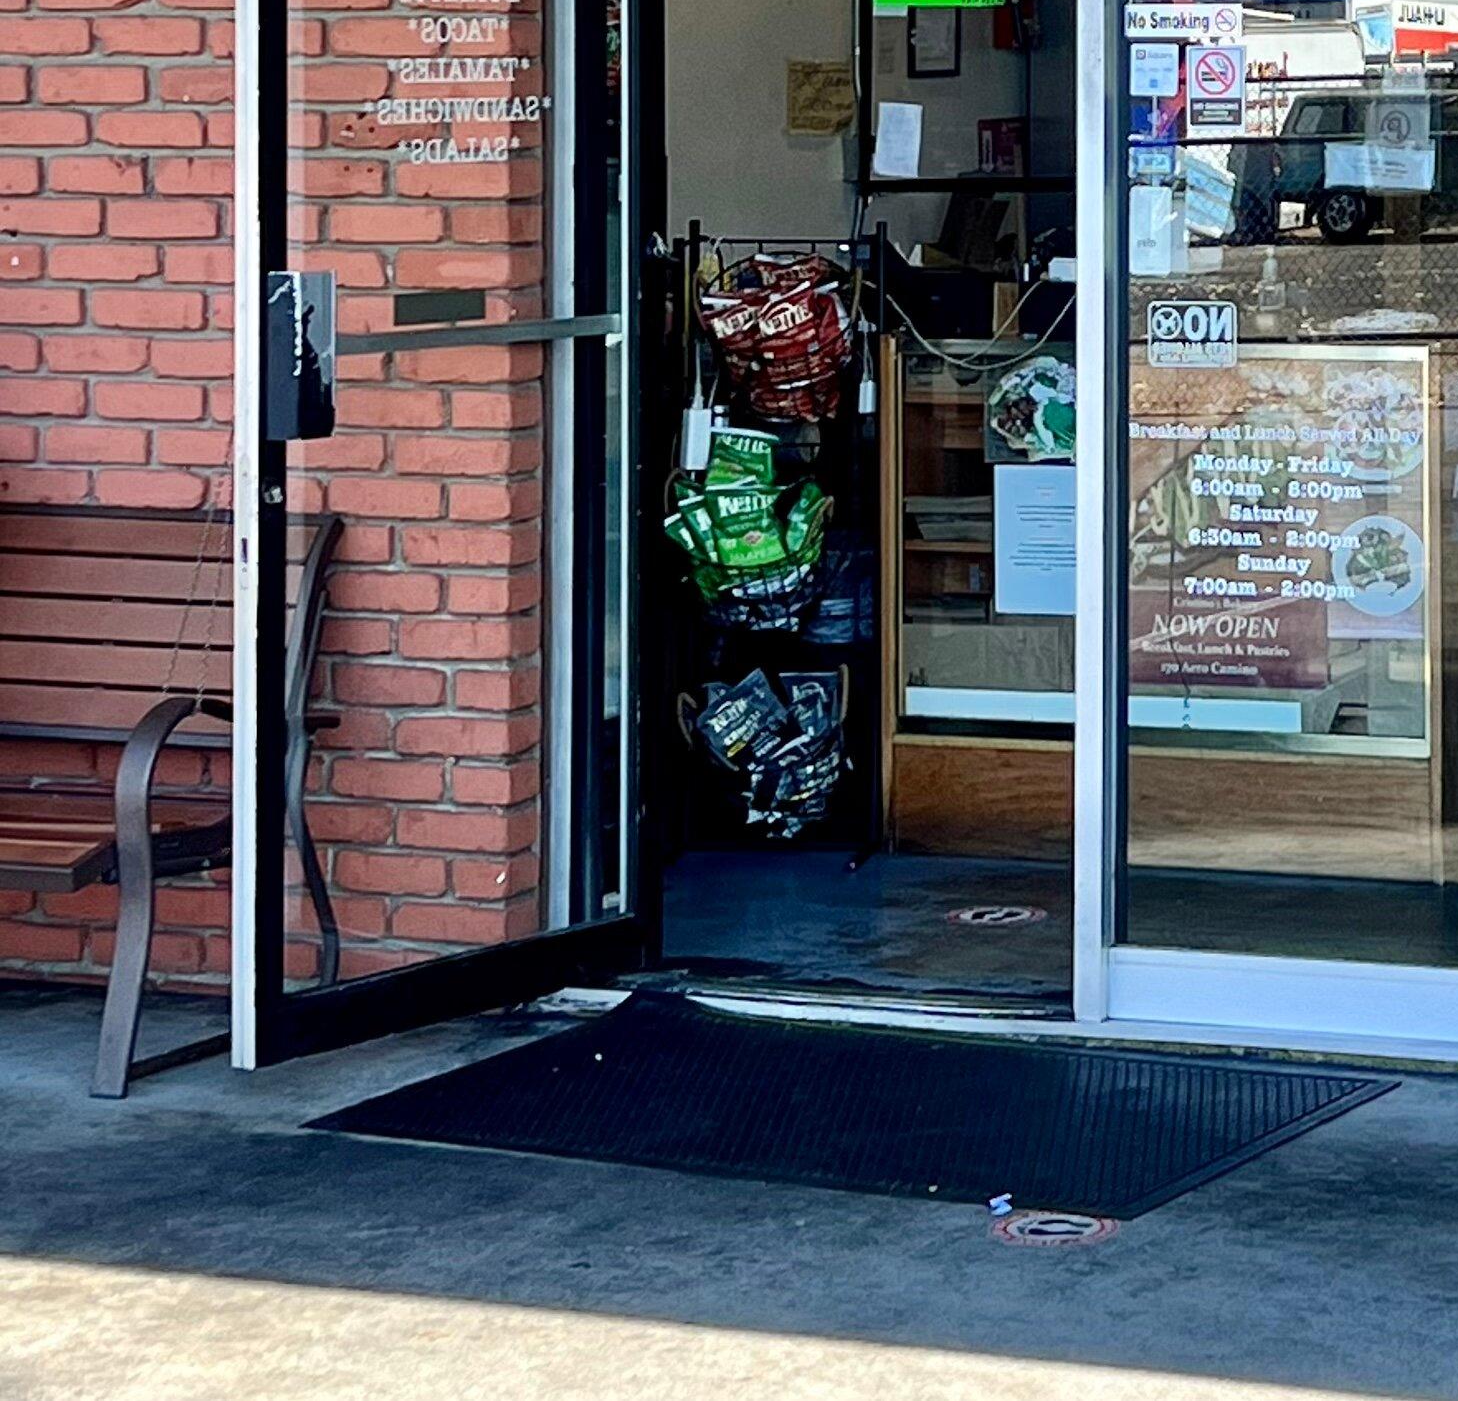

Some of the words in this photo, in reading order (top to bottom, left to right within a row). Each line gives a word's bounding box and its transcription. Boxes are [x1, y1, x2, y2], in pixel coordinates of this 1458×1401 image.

[1127, 11, 1147, 29] No
[1150, 11, 1210, 33] Smoking
[1129, 422, 1207, 441] Breakfast
[1209, 424, 1242, 441] and
[1245, 425, 1297, 442] Lunch
[1390, 428, 1422, 447] Day
[1193, 454, 1274, 477] Monday
[1287, 456, 1355, 477] Friday
[1228, 504, 1320, 527] Saturday
[1285, 530, 1361, 552] 2:00pm
[1237, 553, 1312, 577] Sunday
[1184, 577, 1258, 597] 7:00am
[1280, 580, 1356, 602] 2:00pm
[1152, 614, 1209, 637] NOW
[1215, 615, 1281, 639] OPEN
